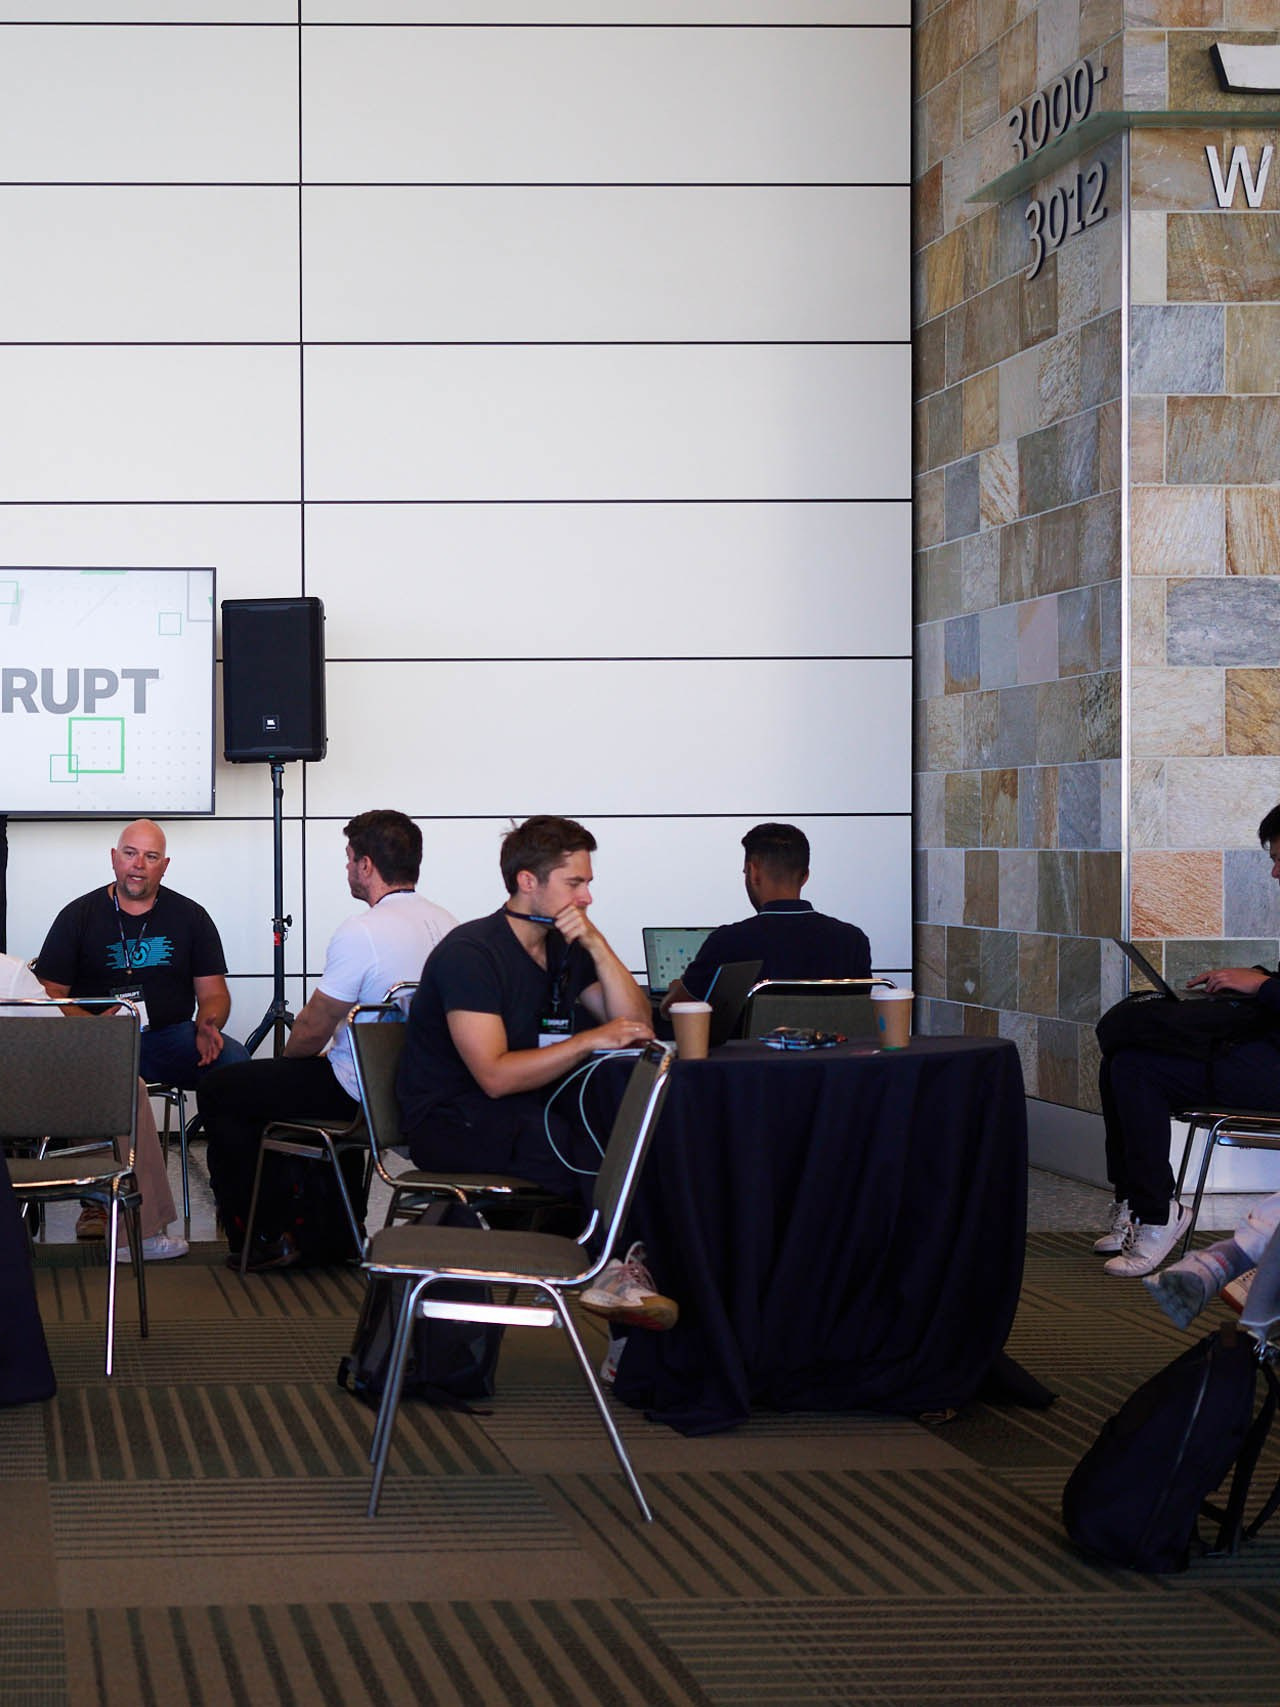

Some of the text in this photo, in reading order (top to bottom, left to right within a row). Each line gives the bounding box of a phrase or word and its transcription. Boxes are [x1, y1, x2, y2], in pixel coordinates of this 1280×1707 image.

[1009, 59, 1108, 161] 3000-
[1025, 161, 1108, 280] 3012
[1205, 145, 1274, 209] W
